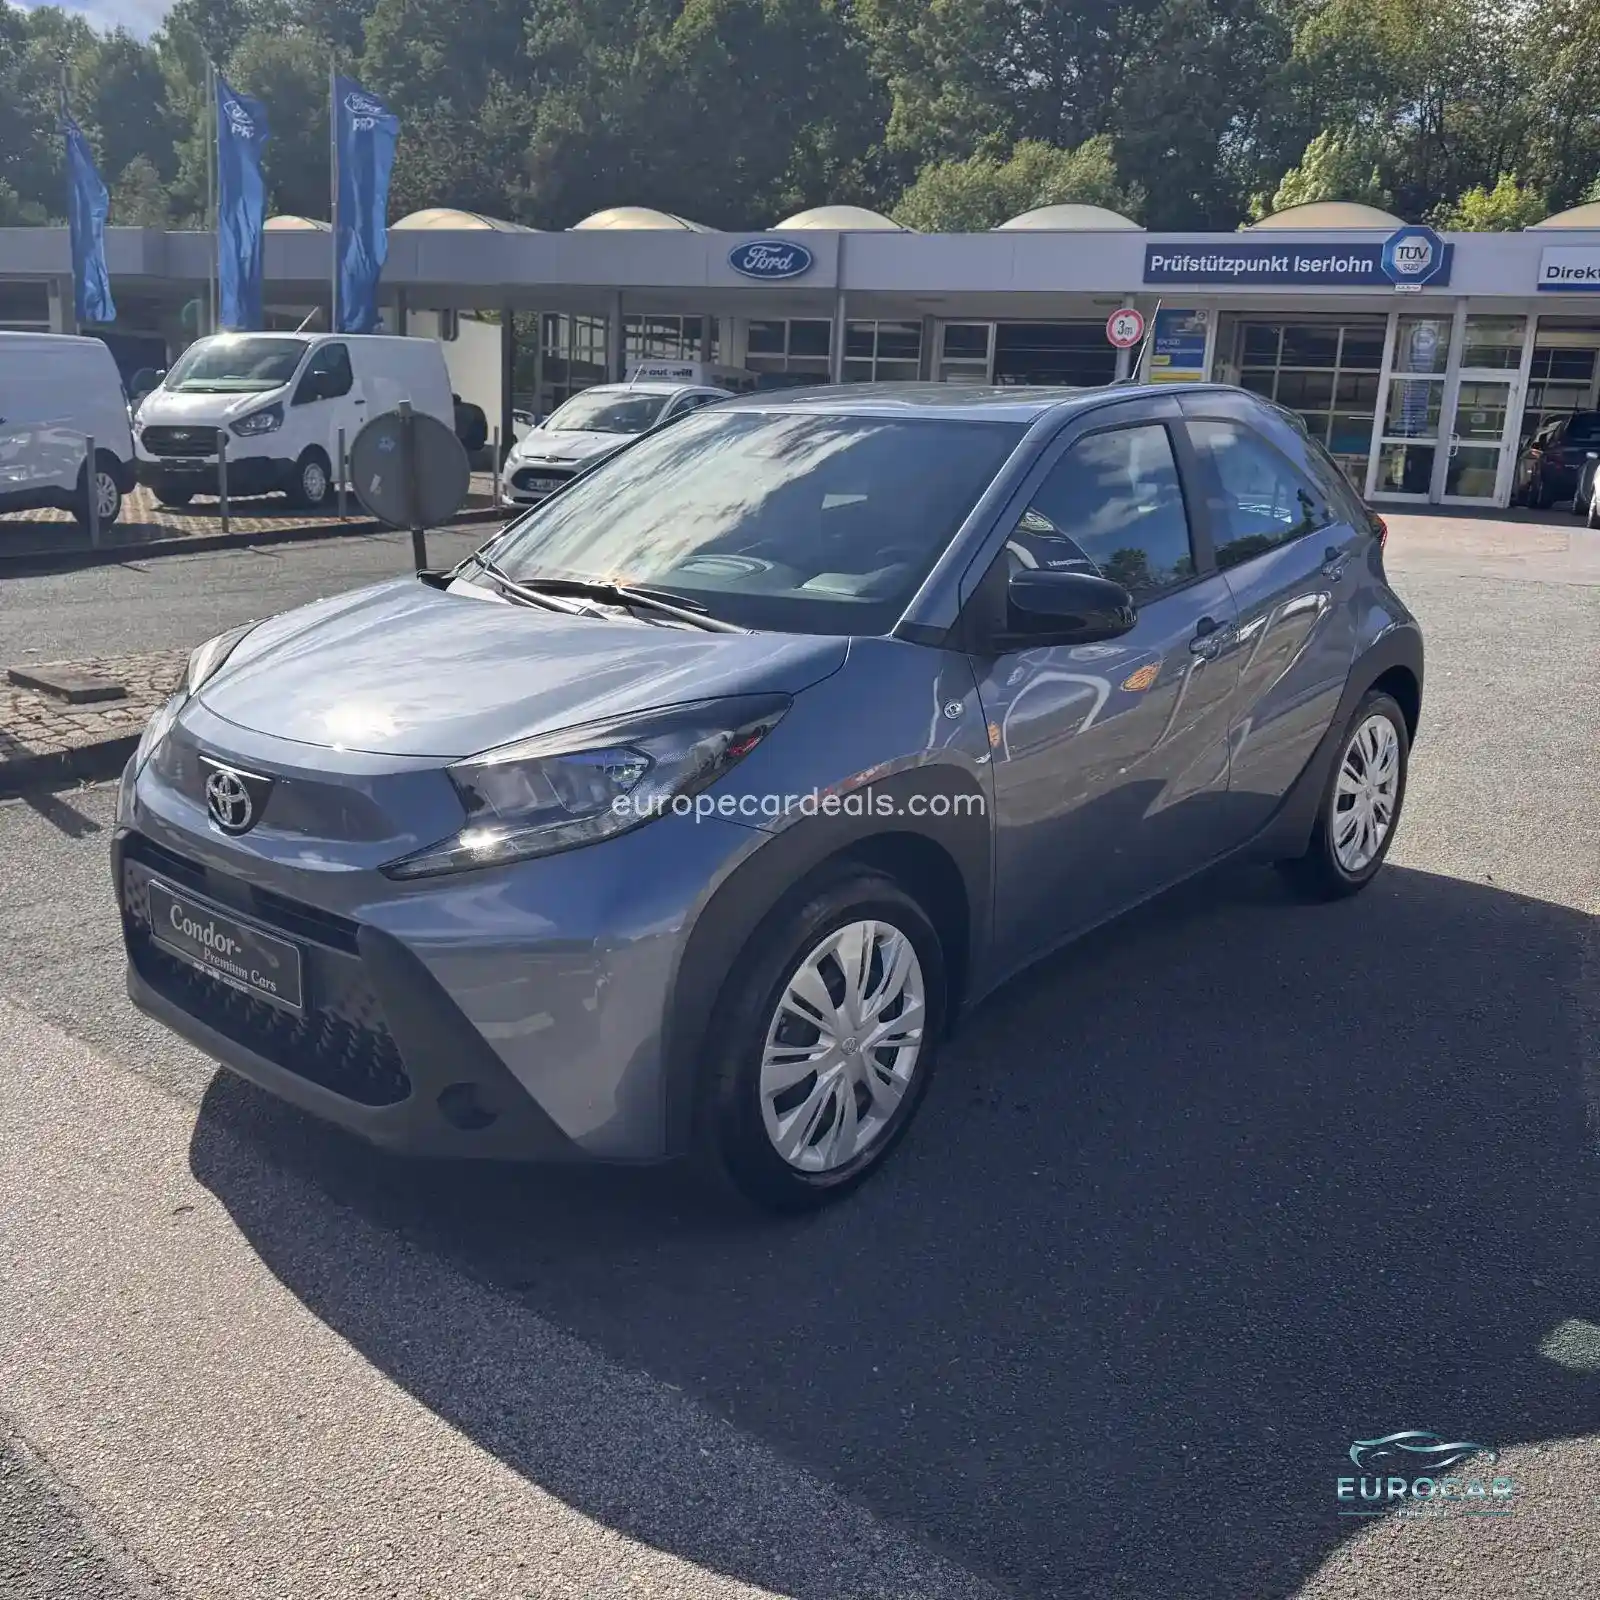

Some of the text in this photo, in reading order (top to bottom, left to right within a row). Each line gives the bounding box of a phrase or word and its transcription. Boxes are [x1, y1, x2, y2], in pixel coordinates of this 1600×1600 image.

[743, 245, 795, 270] Ford
[1398, 246, 1428, 260] TÜV
[1150, 255, 1374, 276] Prüfstützpunkt Iserlohn
[1118, 320, 1125, 335] 3
[203, 947, 248, 980] Premium
[251, 969, 277, 992] Cars
